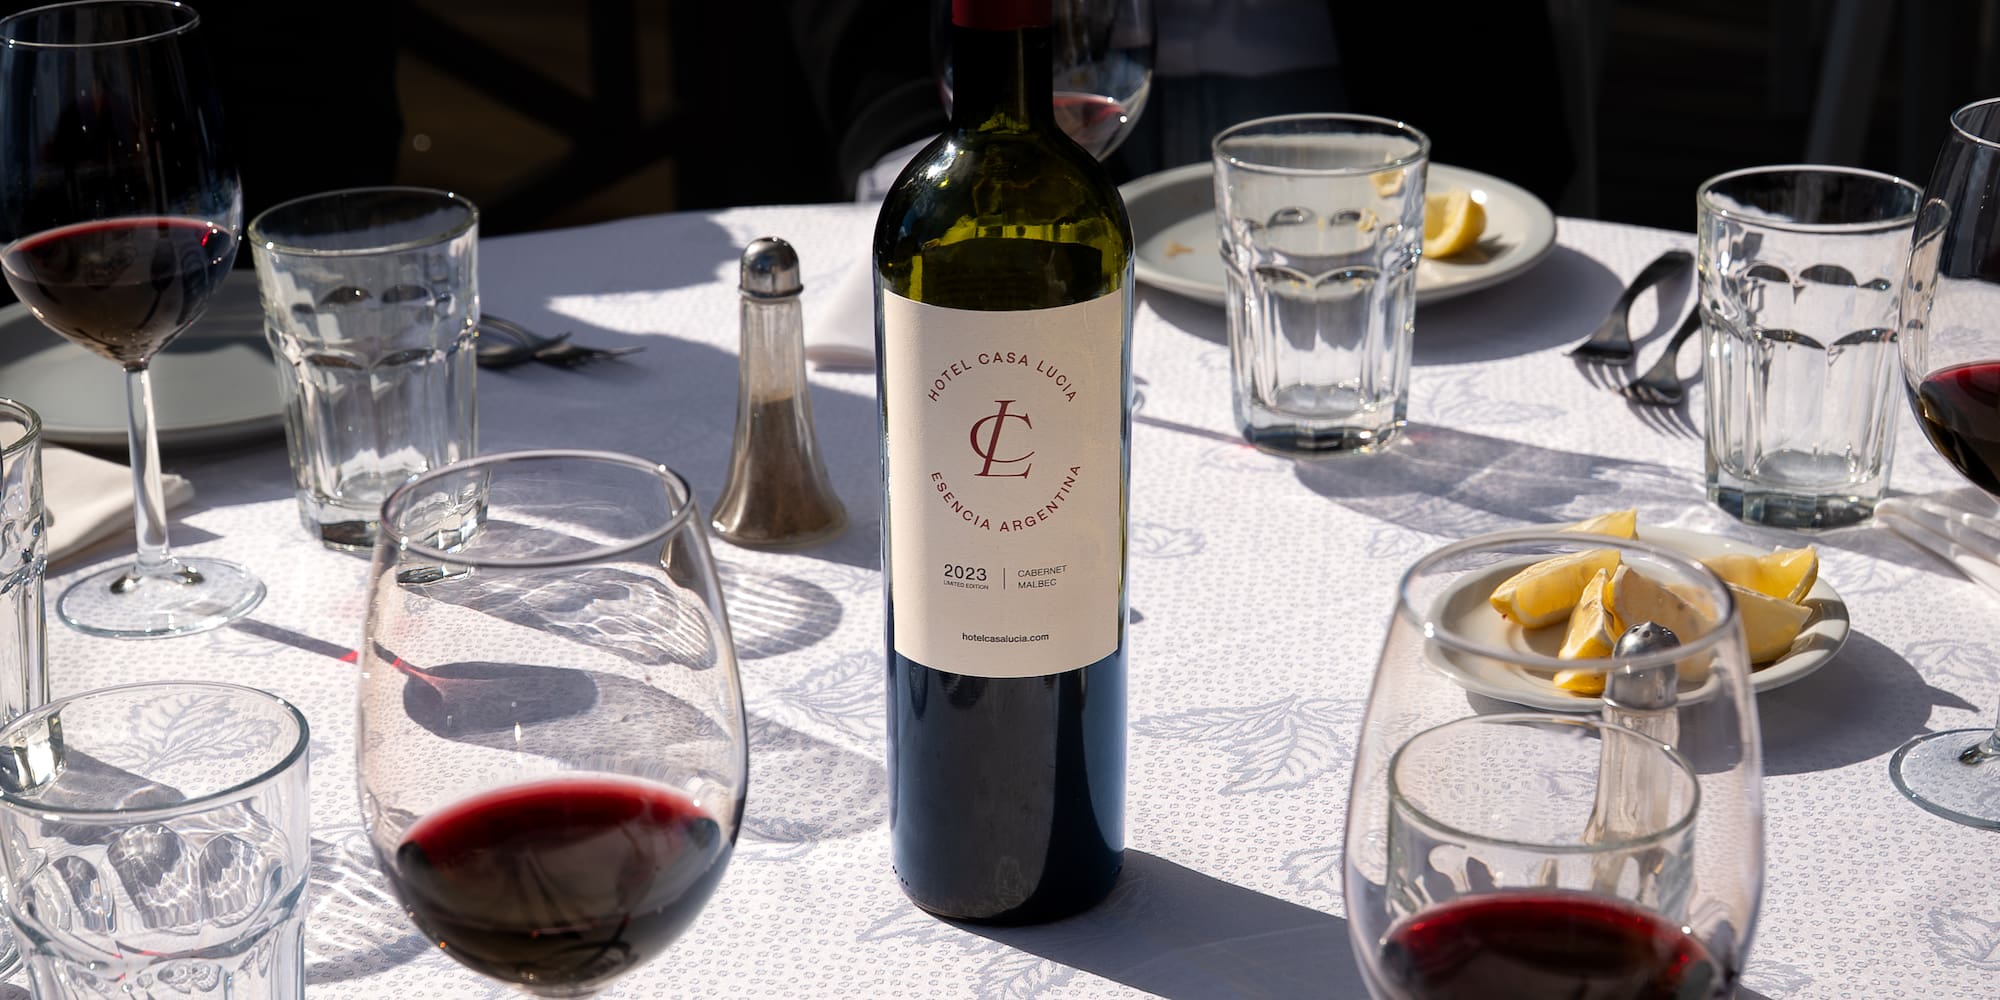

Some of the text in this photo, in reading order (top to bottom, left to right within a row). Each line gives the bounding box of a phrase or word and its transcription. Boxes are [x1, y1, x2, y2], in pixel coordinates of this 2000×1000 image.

[928, 352, 1077, 402] HOTEL CASA LUCIA
[931, 466, 1081, 532] ESENCIA ARGENTINA
[944, 564, 987, 581] 2023
[1017, 565, 1067, 578] CABERNET
[943, 580, 965, 588] LIMITED
[1017, 578, 1057, 589] MALBEC
[962, 632, 1049, 643] hotelcasalucia.com
